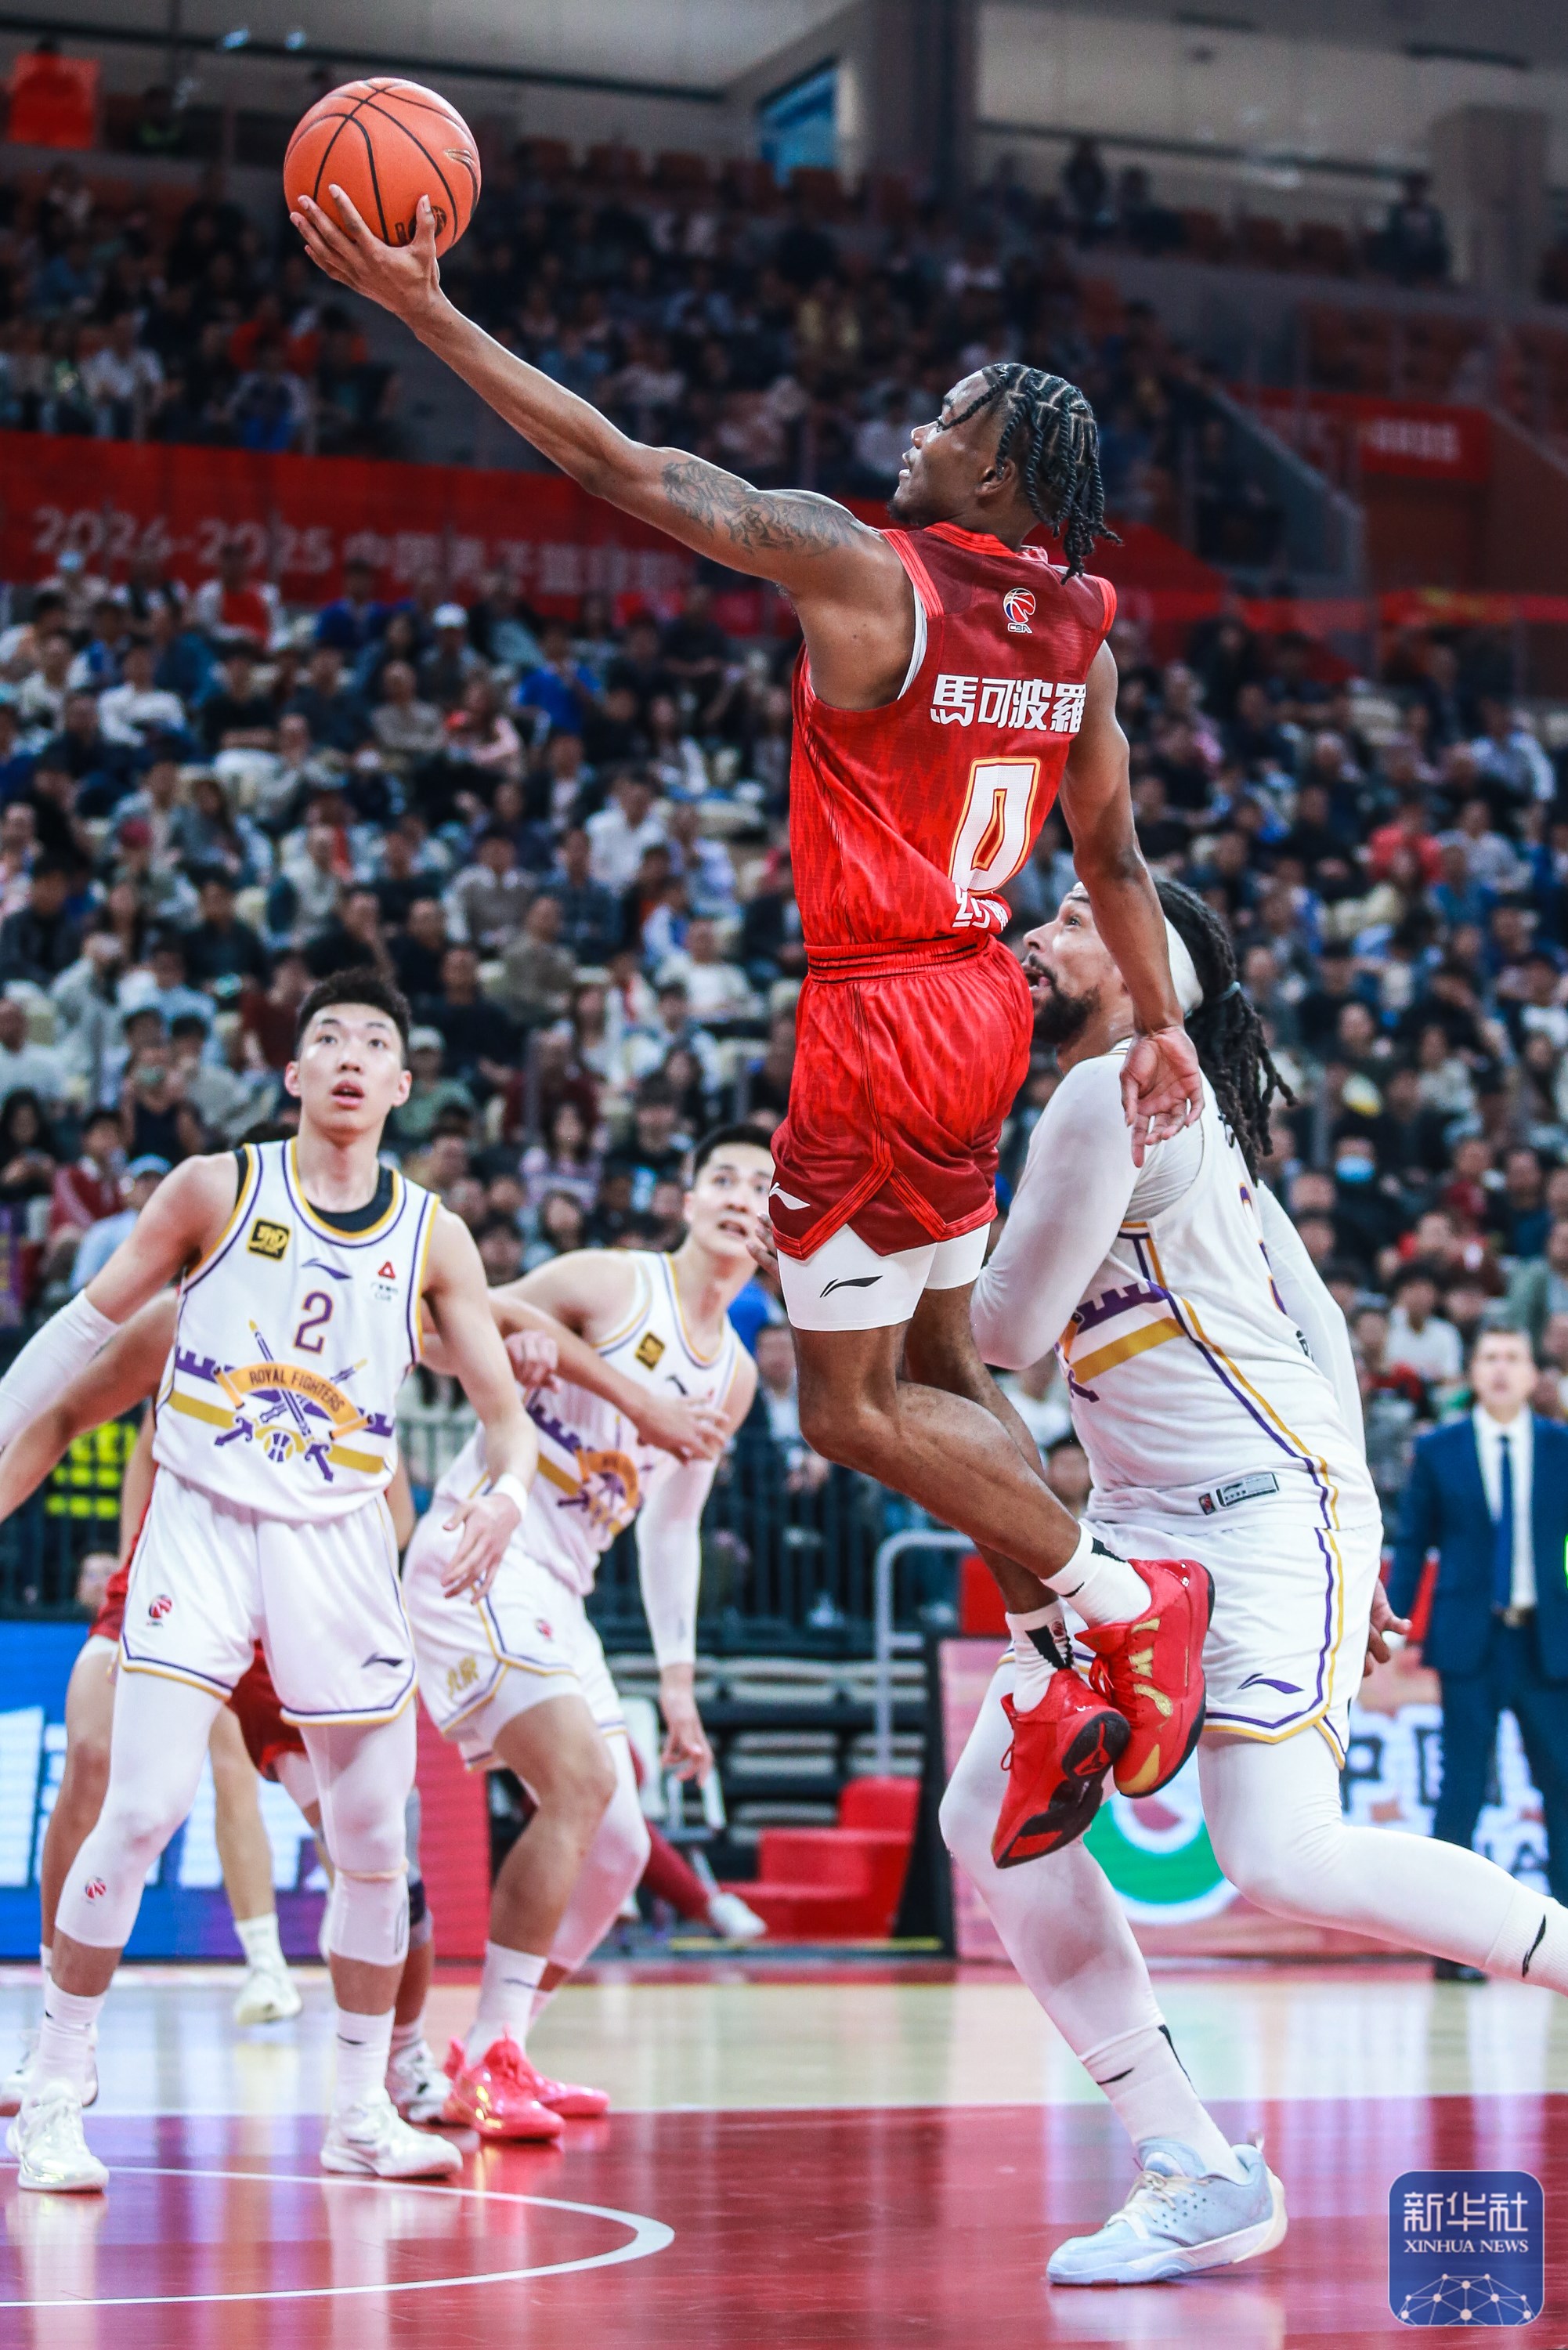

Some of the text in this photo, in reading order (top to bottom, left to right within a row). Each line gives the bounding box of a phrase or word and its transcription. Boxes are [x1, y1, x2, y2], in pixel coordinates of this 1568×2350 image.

[930, 674, 1087, 734] 馬可波羅
[948, 756, 1041, 896] 0
[293, 1289, 334, 1355] 2
[249, 1368, 345, 1412] ROYAL FIGHTERS
